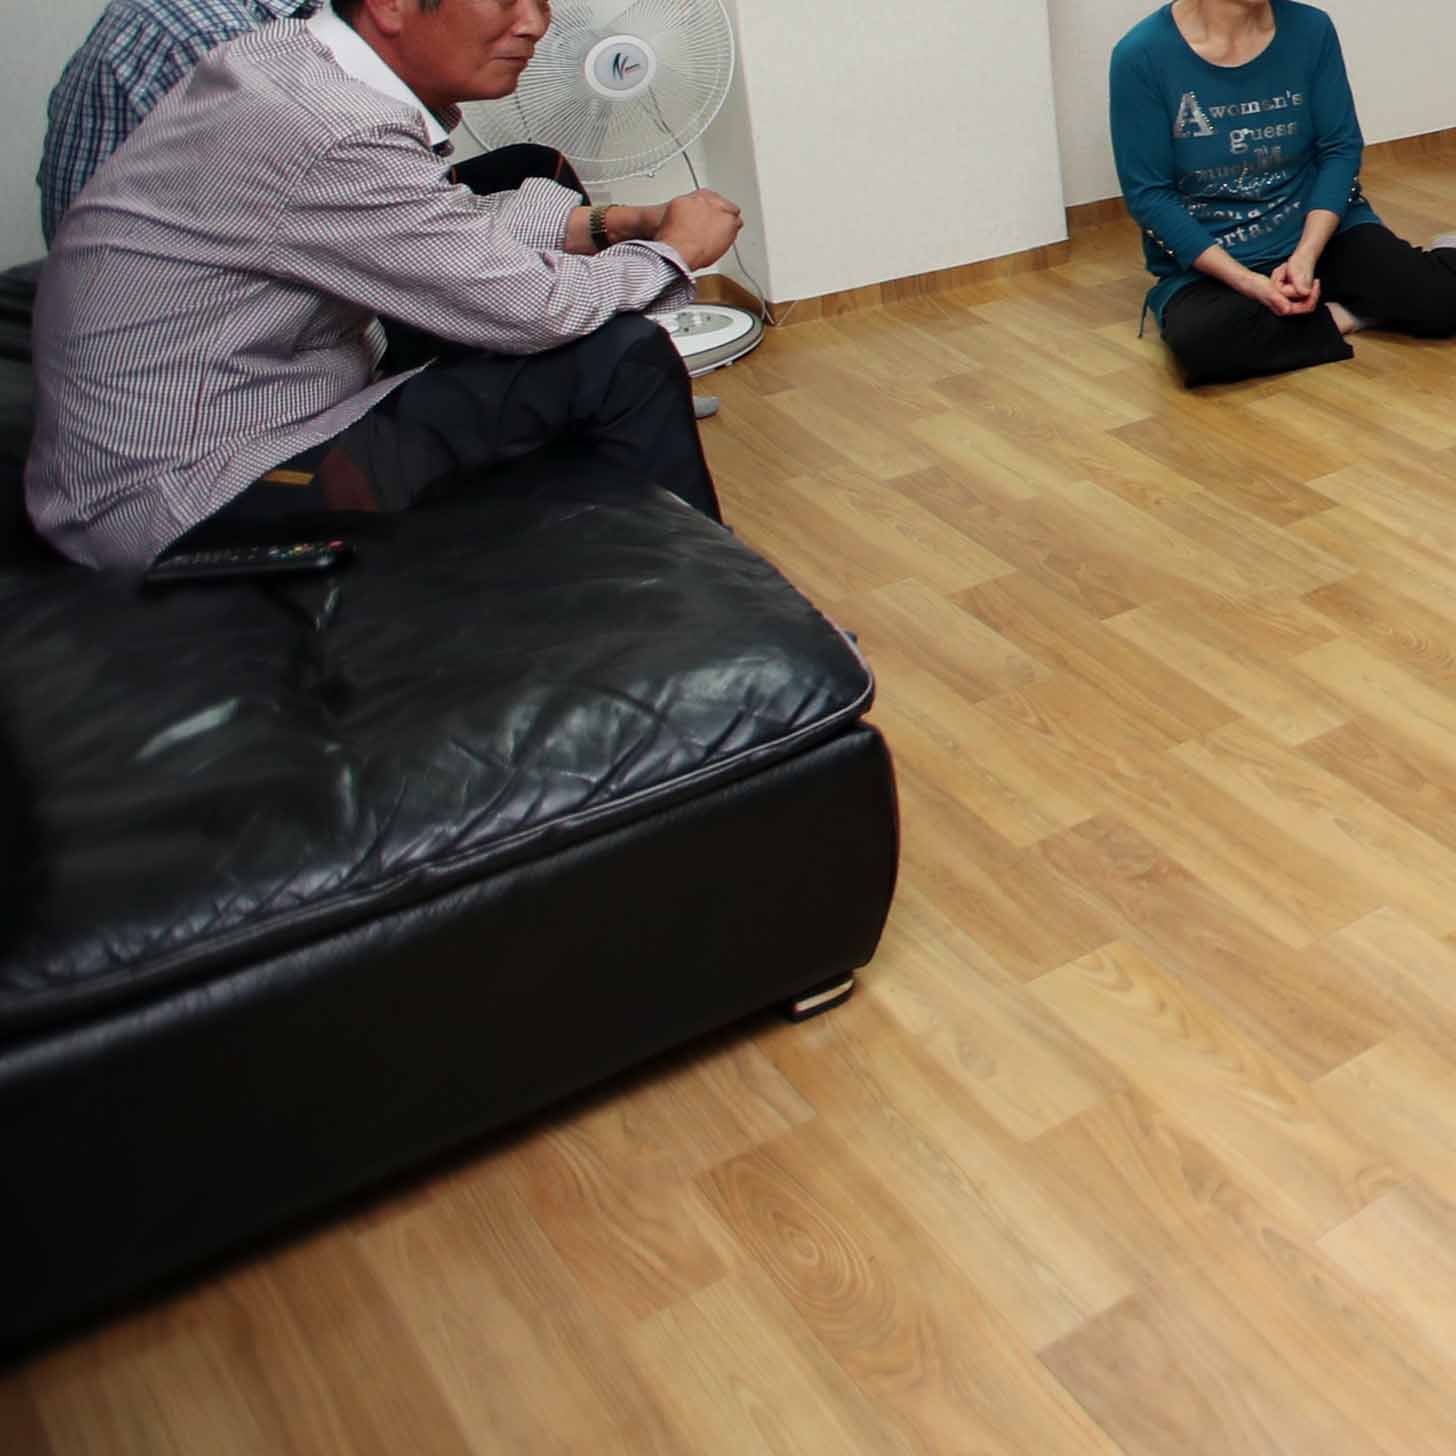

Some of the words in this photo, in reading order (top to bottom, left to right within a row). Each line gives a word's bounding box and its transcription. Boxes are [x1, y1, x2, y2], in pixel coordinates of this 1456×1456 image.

[1173, 91, 1216, 138] A
[1209, 89, 1304, 119] woman's
[1229, 122, 1298, 155] guess
